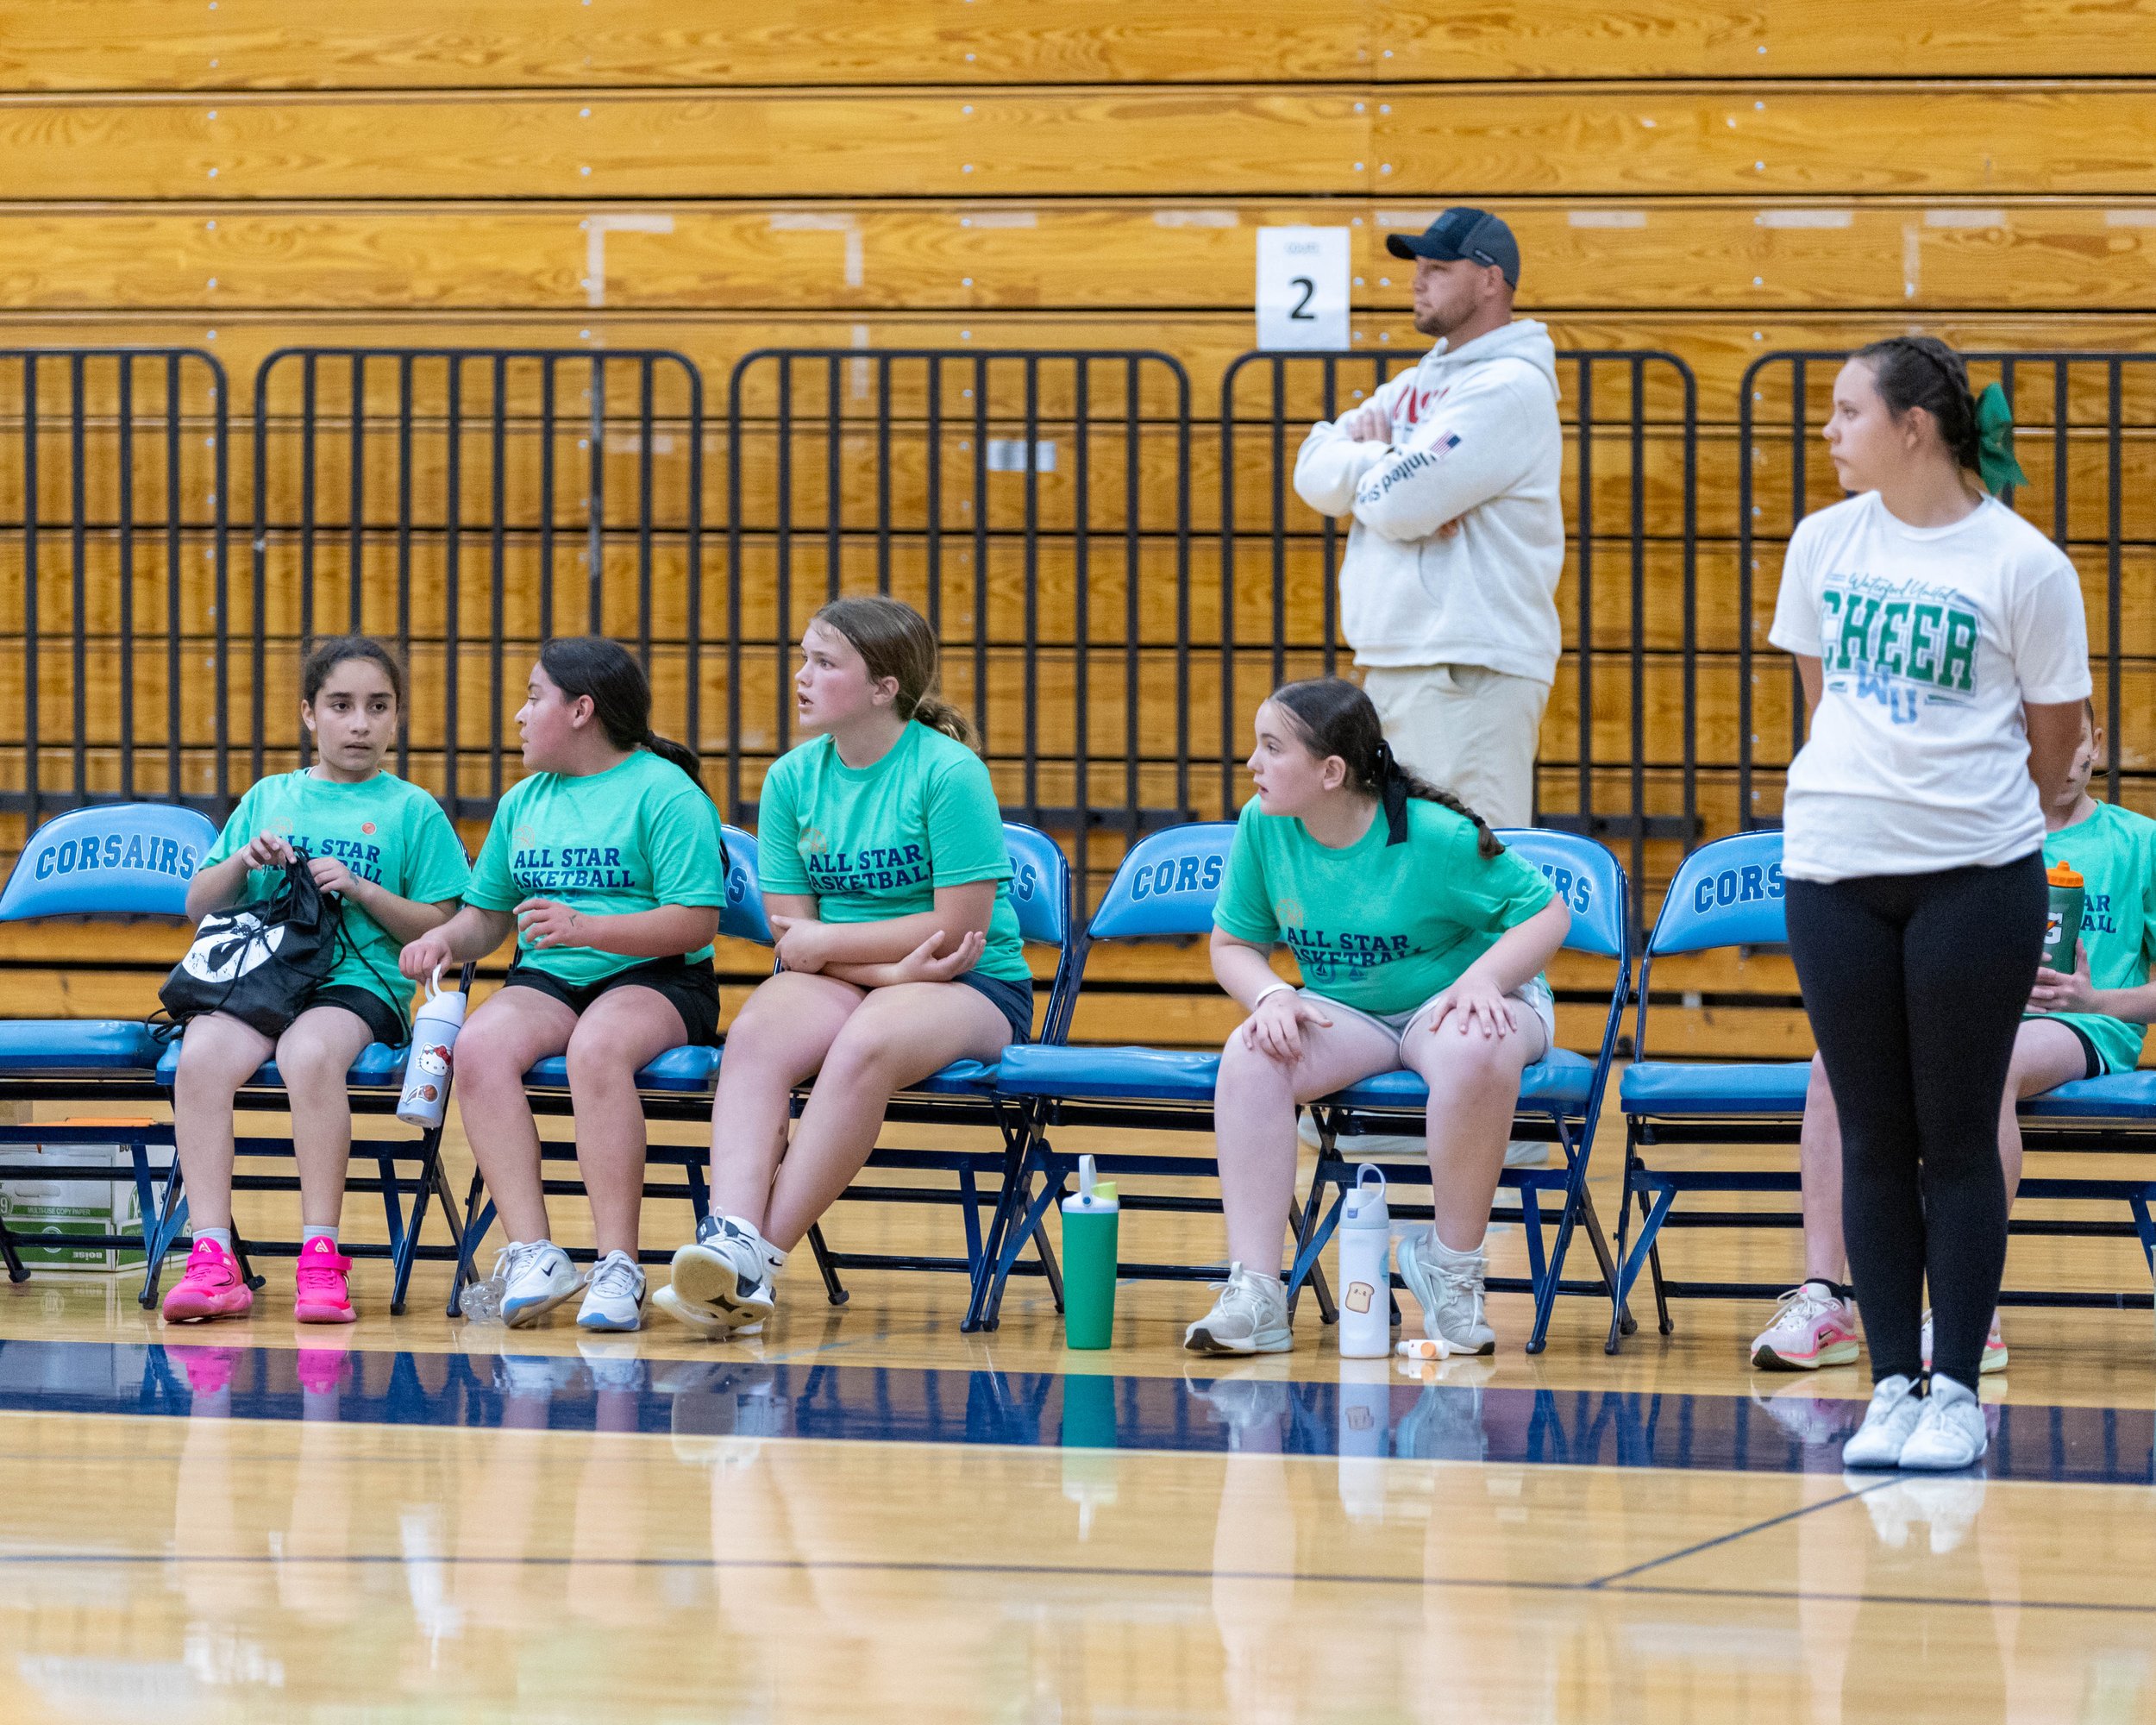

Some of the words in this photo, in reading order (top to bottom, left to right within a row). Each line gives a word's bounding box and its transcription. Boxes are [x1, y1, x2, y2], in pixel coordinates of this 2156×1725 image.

[1291, 278, 1315, 319] 2
[34, 833, 198, 881] CORSAIRS
[320, 838, 381, 863] STAR
[514, 850, 554, 869] ALL
[561, 848, 621, 868] STAR
[809, 854, 853, 873] ALL
[859, 844, 924, 870] STAR
[512, 869, 636, 888] ASKETBALL
[810, 861, 933, 891] ASKETBAL
[1130, 854, 1225, 902] CORS
[1693, 862, 1785, 915] CORS
[2083, 894, 2111, 912] AR
[1287, 926, 1332, 948] ALL
[1339, 932, 1411, 951] STAR
[56, 1207, 72, 1215] COPY
